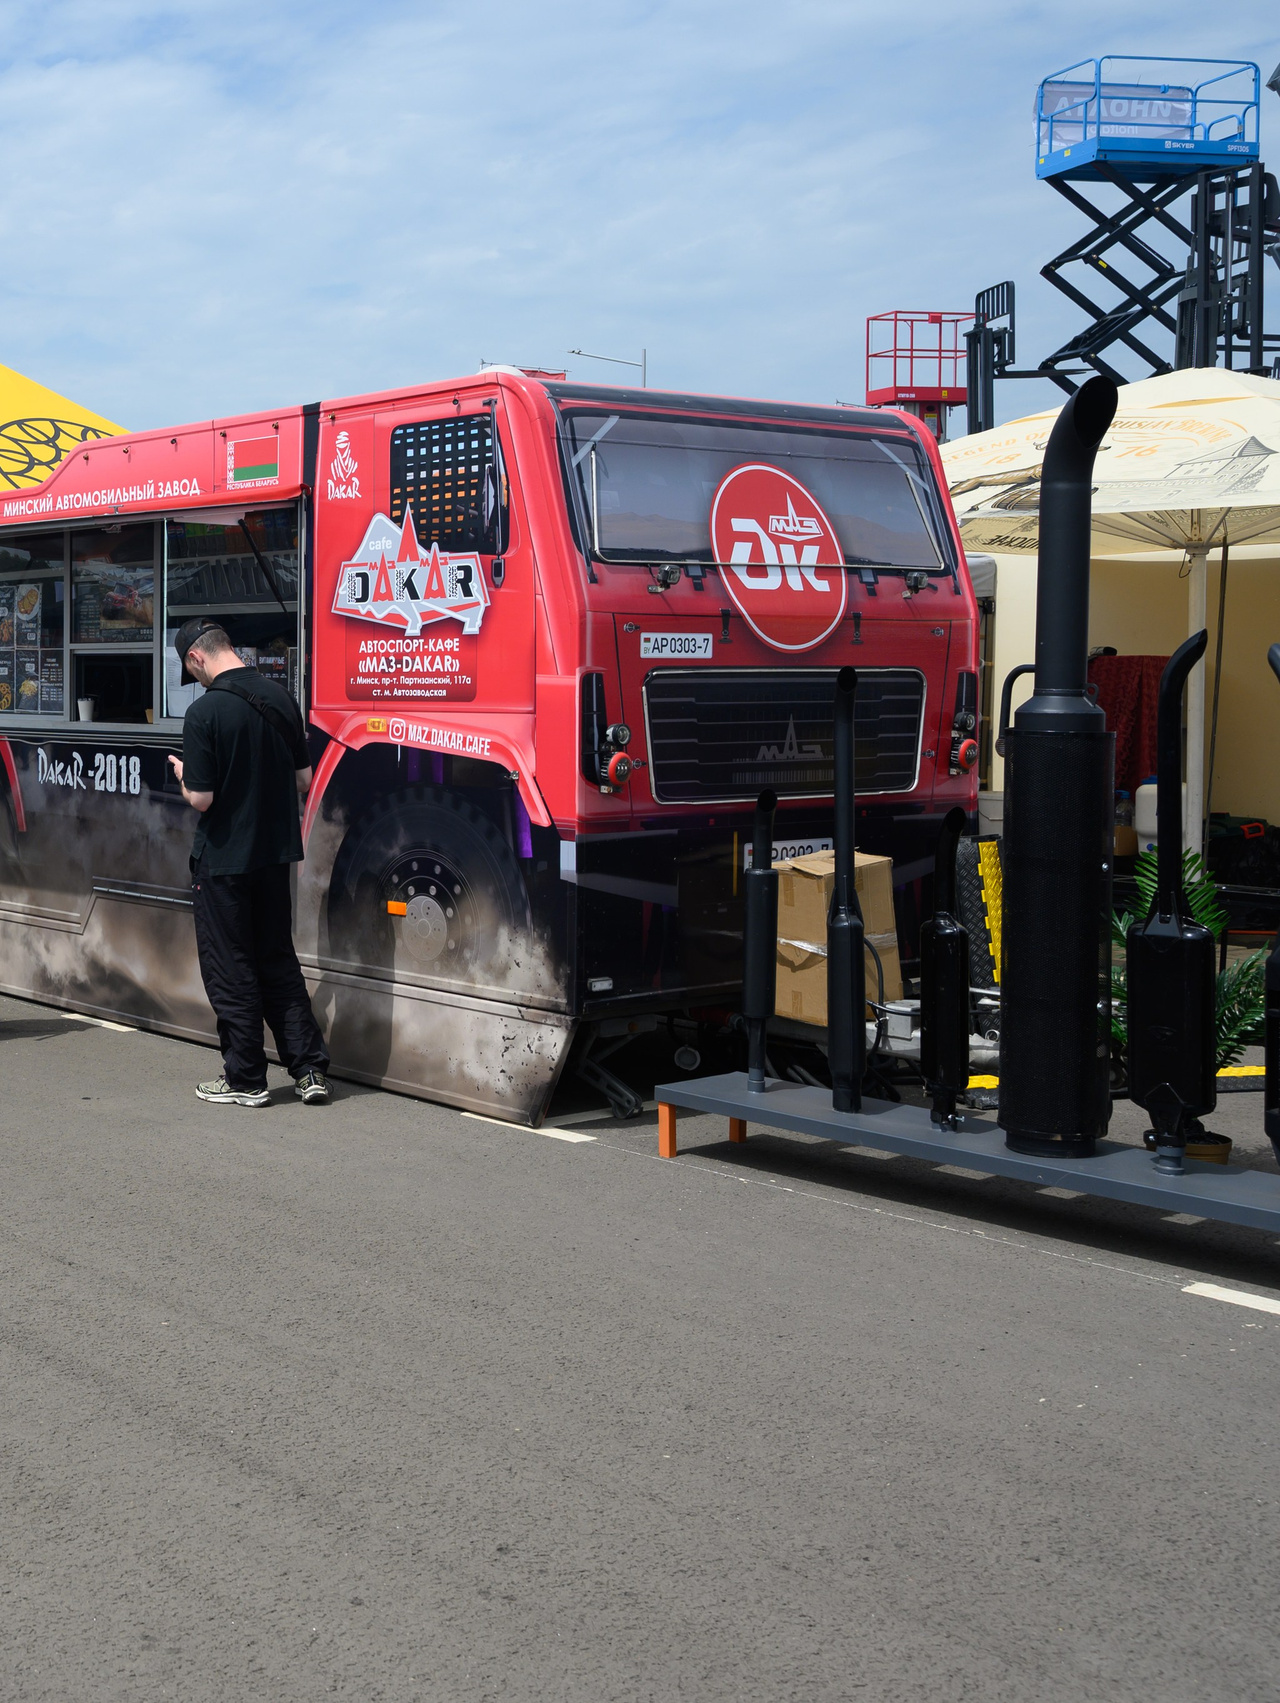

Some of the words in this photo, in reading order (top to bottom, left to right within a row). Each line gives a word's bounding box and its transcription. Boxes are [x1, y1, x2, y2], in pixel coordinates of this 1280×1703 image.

[226, 481, 255, 491] РЕСПУБЛИКА
[255, 478, 279, 487] БЕЛАРУСЬ
[328, 477, 361, 500] DAKAR
[3, 496, 53, 517] МИНСКИЙ
[56, 482, 155, 511] АВТОМОБИЛЬНЫЙ
[157, 477, 200, 499] ЗАВОД
[369, 537, 392, 551] cafe
[347, 550, 474, 604] DAKAR
[359, 638, 460, 653] АВТОСПОРТ-КАФЕ
[651, 637, 709, 653] AP0303-7
[356, 676, 380, 685] Минск,
[382, 678, 399, 686] пр-т.
[400, 675, 452, 686] Партизанский,
[393, 688, 447, 697] Автозаводская
[408, 723, 491, 756] MAZ.DAKAR.CAFE
